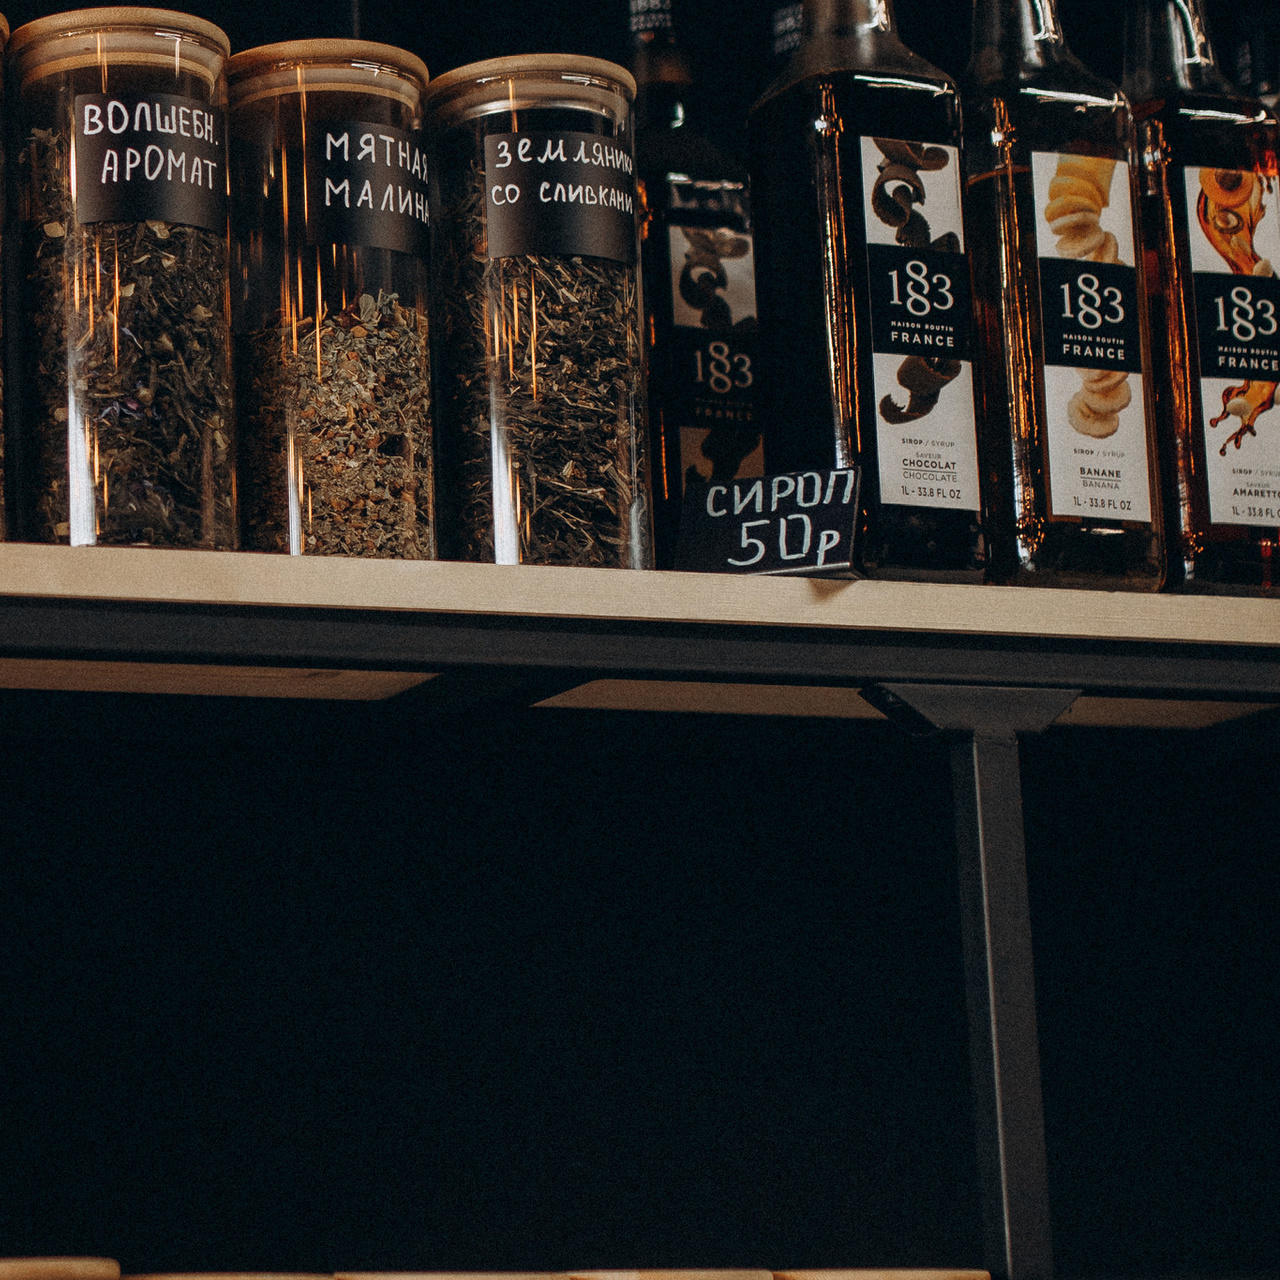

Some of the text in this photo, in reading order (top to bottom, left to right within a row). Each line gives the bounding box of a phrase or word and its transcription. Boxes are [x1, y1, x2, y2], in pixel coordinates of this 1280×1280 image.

[83, 100, 219, 146] ВОЛШЕБН.
[101, 144, 217, 189] АРОМАТ
[325, 131, 428, 185] МЯТНАЯ
[324, 176, 430, 227] МАЛИНА
[888, 260, 954, 316] 1883
[1061, 273, 1124, 329] 1883
[1214, 286, 1278, 342] 1883
[891, 331, 954, 348] FRANCE
[1063, 343, 1125, 360] FRANCE
[695, 341, 753, 393] 1883
[1218, 355, 1279, 371] FRANCE
[931, 440, 955, 448] SYRUP
[902, 458, 956, 470] CHOCOLAT
[1080, 467, 1121, 478] BANANE
[903, 471, 957, 483] CHOCOLATE
[1082, 479, 1119, 490] BANANA
[706, 470, 855, 517] СИРОП
[917, 487, 934, 497] 33.8
[937, 488, 947, 498] FL
[949, 489, 961, 499] OZ
[1089, 497, 1105, 508] 33.8
[1108, 499, 1117, 509] FL
[1120, 500, 1131, 511] OZ
